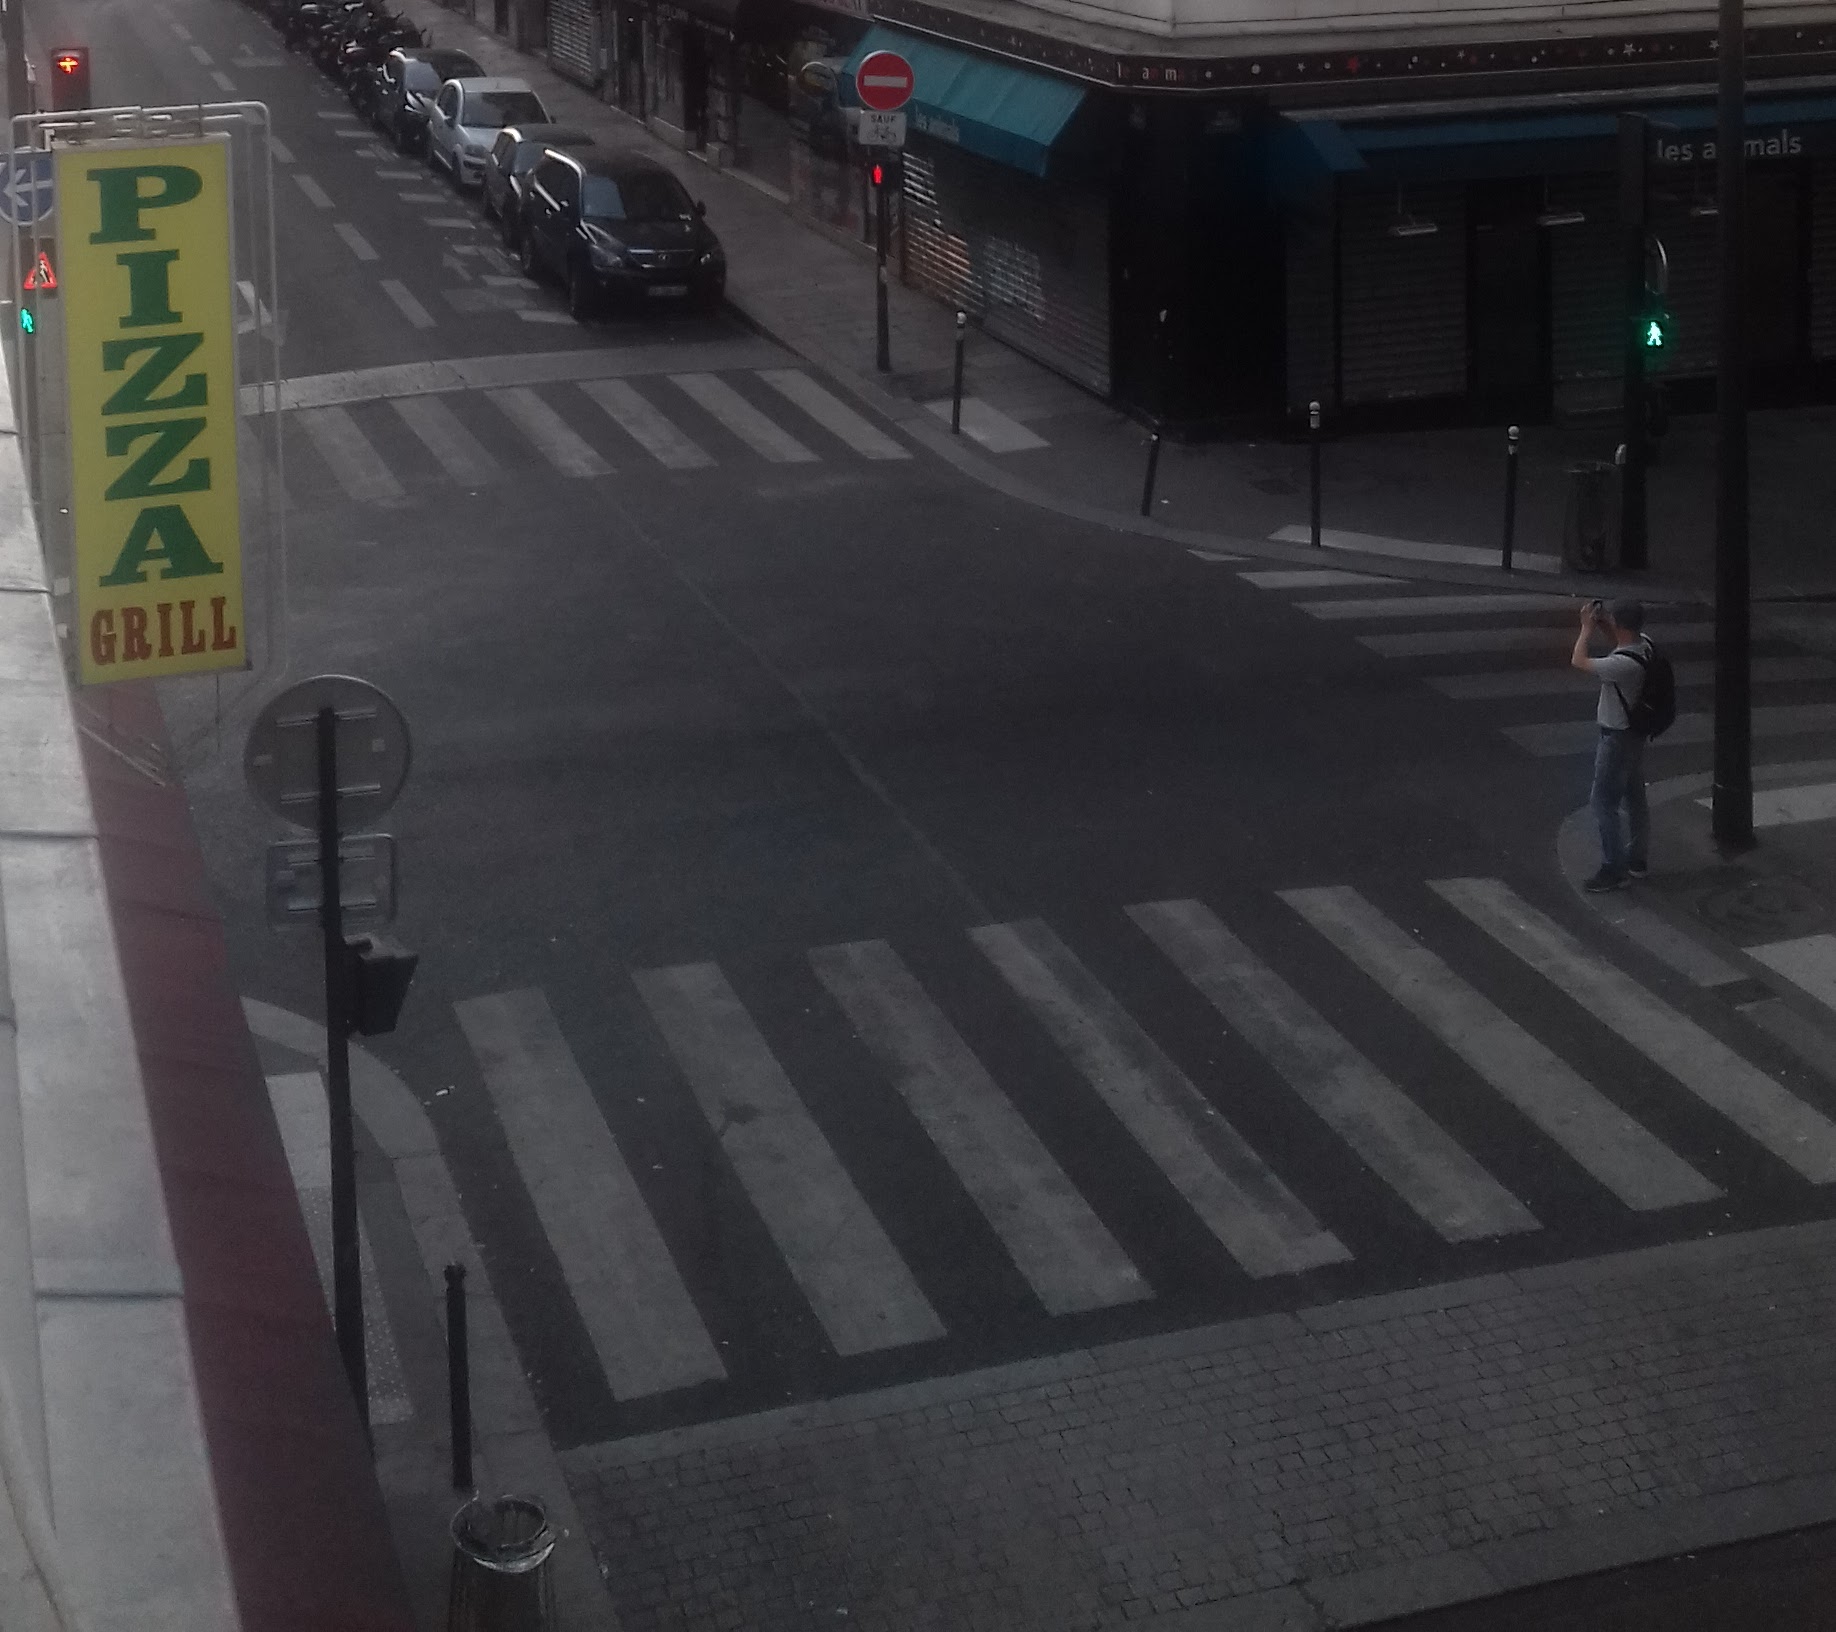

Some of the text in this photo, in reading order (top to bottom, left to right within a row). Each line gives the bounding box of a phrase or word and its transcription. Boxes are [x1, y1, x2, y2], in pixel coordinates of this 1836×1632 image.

[870, 114, 897, 124] SAUF
[1656, 128, 1802, 161] les amals
[88, 165, 224, 588] PIZZA
[90, 595, 238, 666] GRILL
